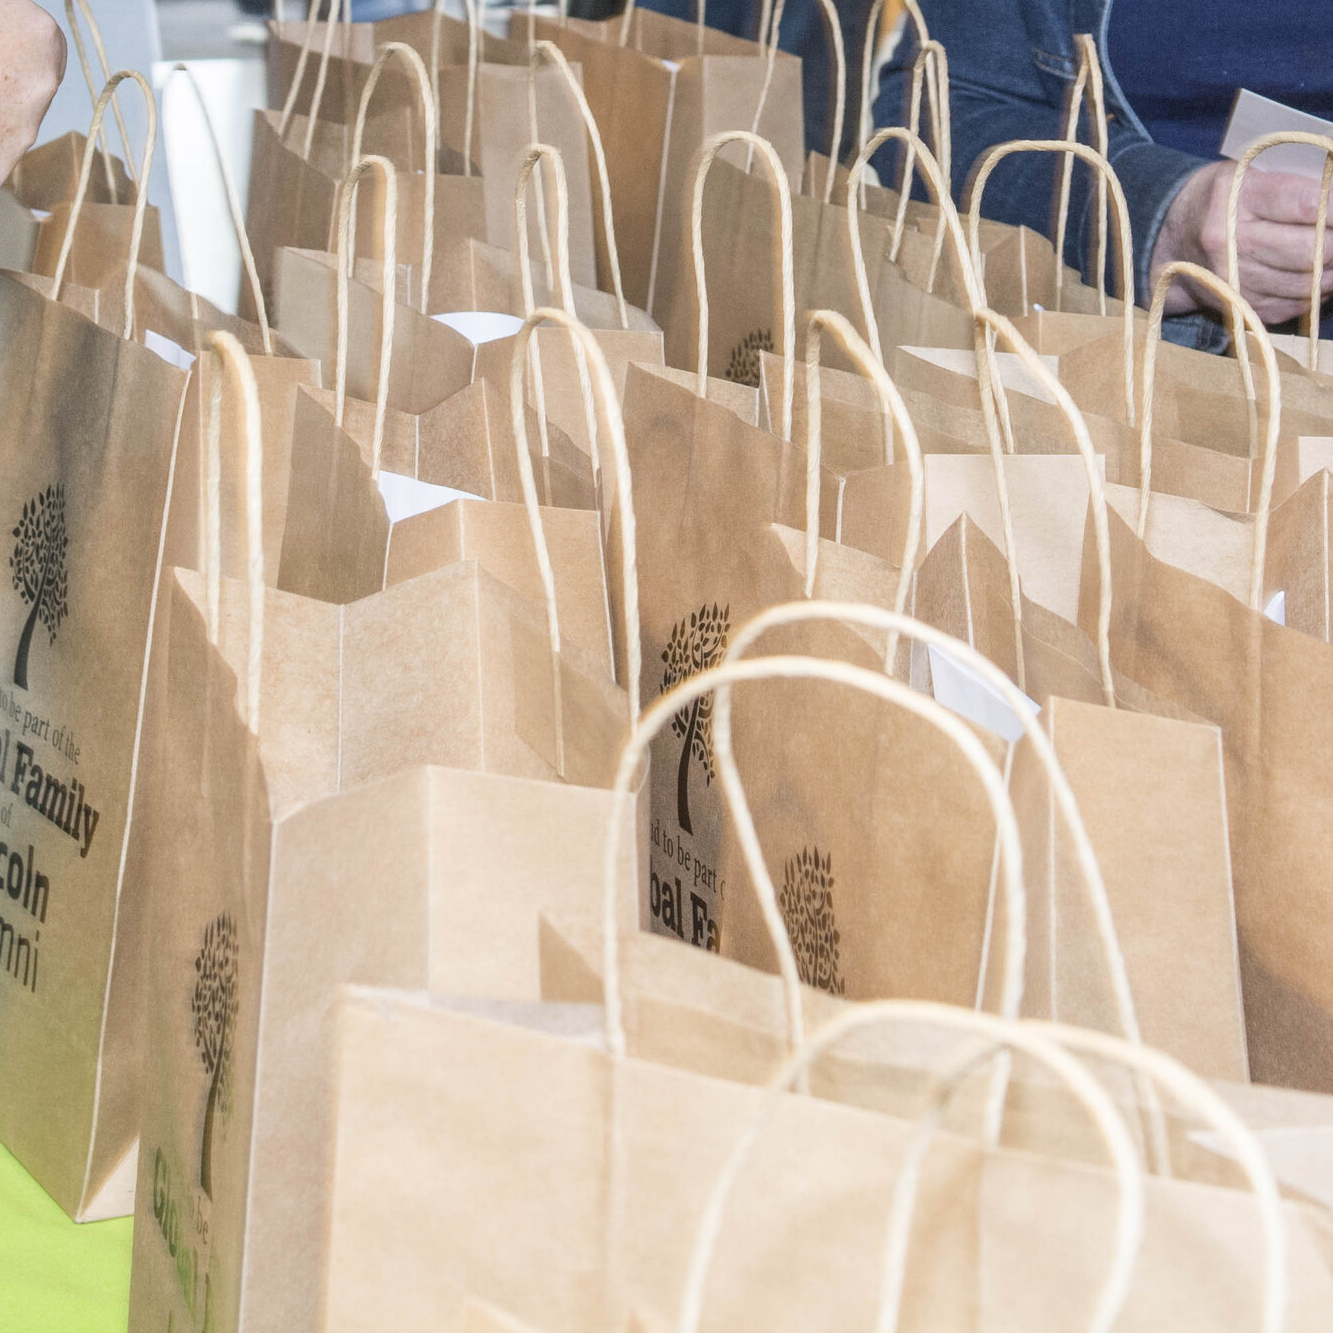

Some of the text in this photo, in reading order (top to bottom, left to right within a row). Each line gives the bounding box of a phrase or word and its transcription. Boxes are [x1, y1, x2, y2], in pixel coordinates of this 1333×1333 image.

[9, 691, 21, 722] be
[22, 710, 51, 742] part
[51, 725, 66, 752] of
[65, 731, 81, 765] the
[0, 802, 13, 828] of
[10, 740, 100, 859] Family
[663, 829, 674, 858] to
[677, 835, 691, 871] be
[693, 857, 717, 893] part
